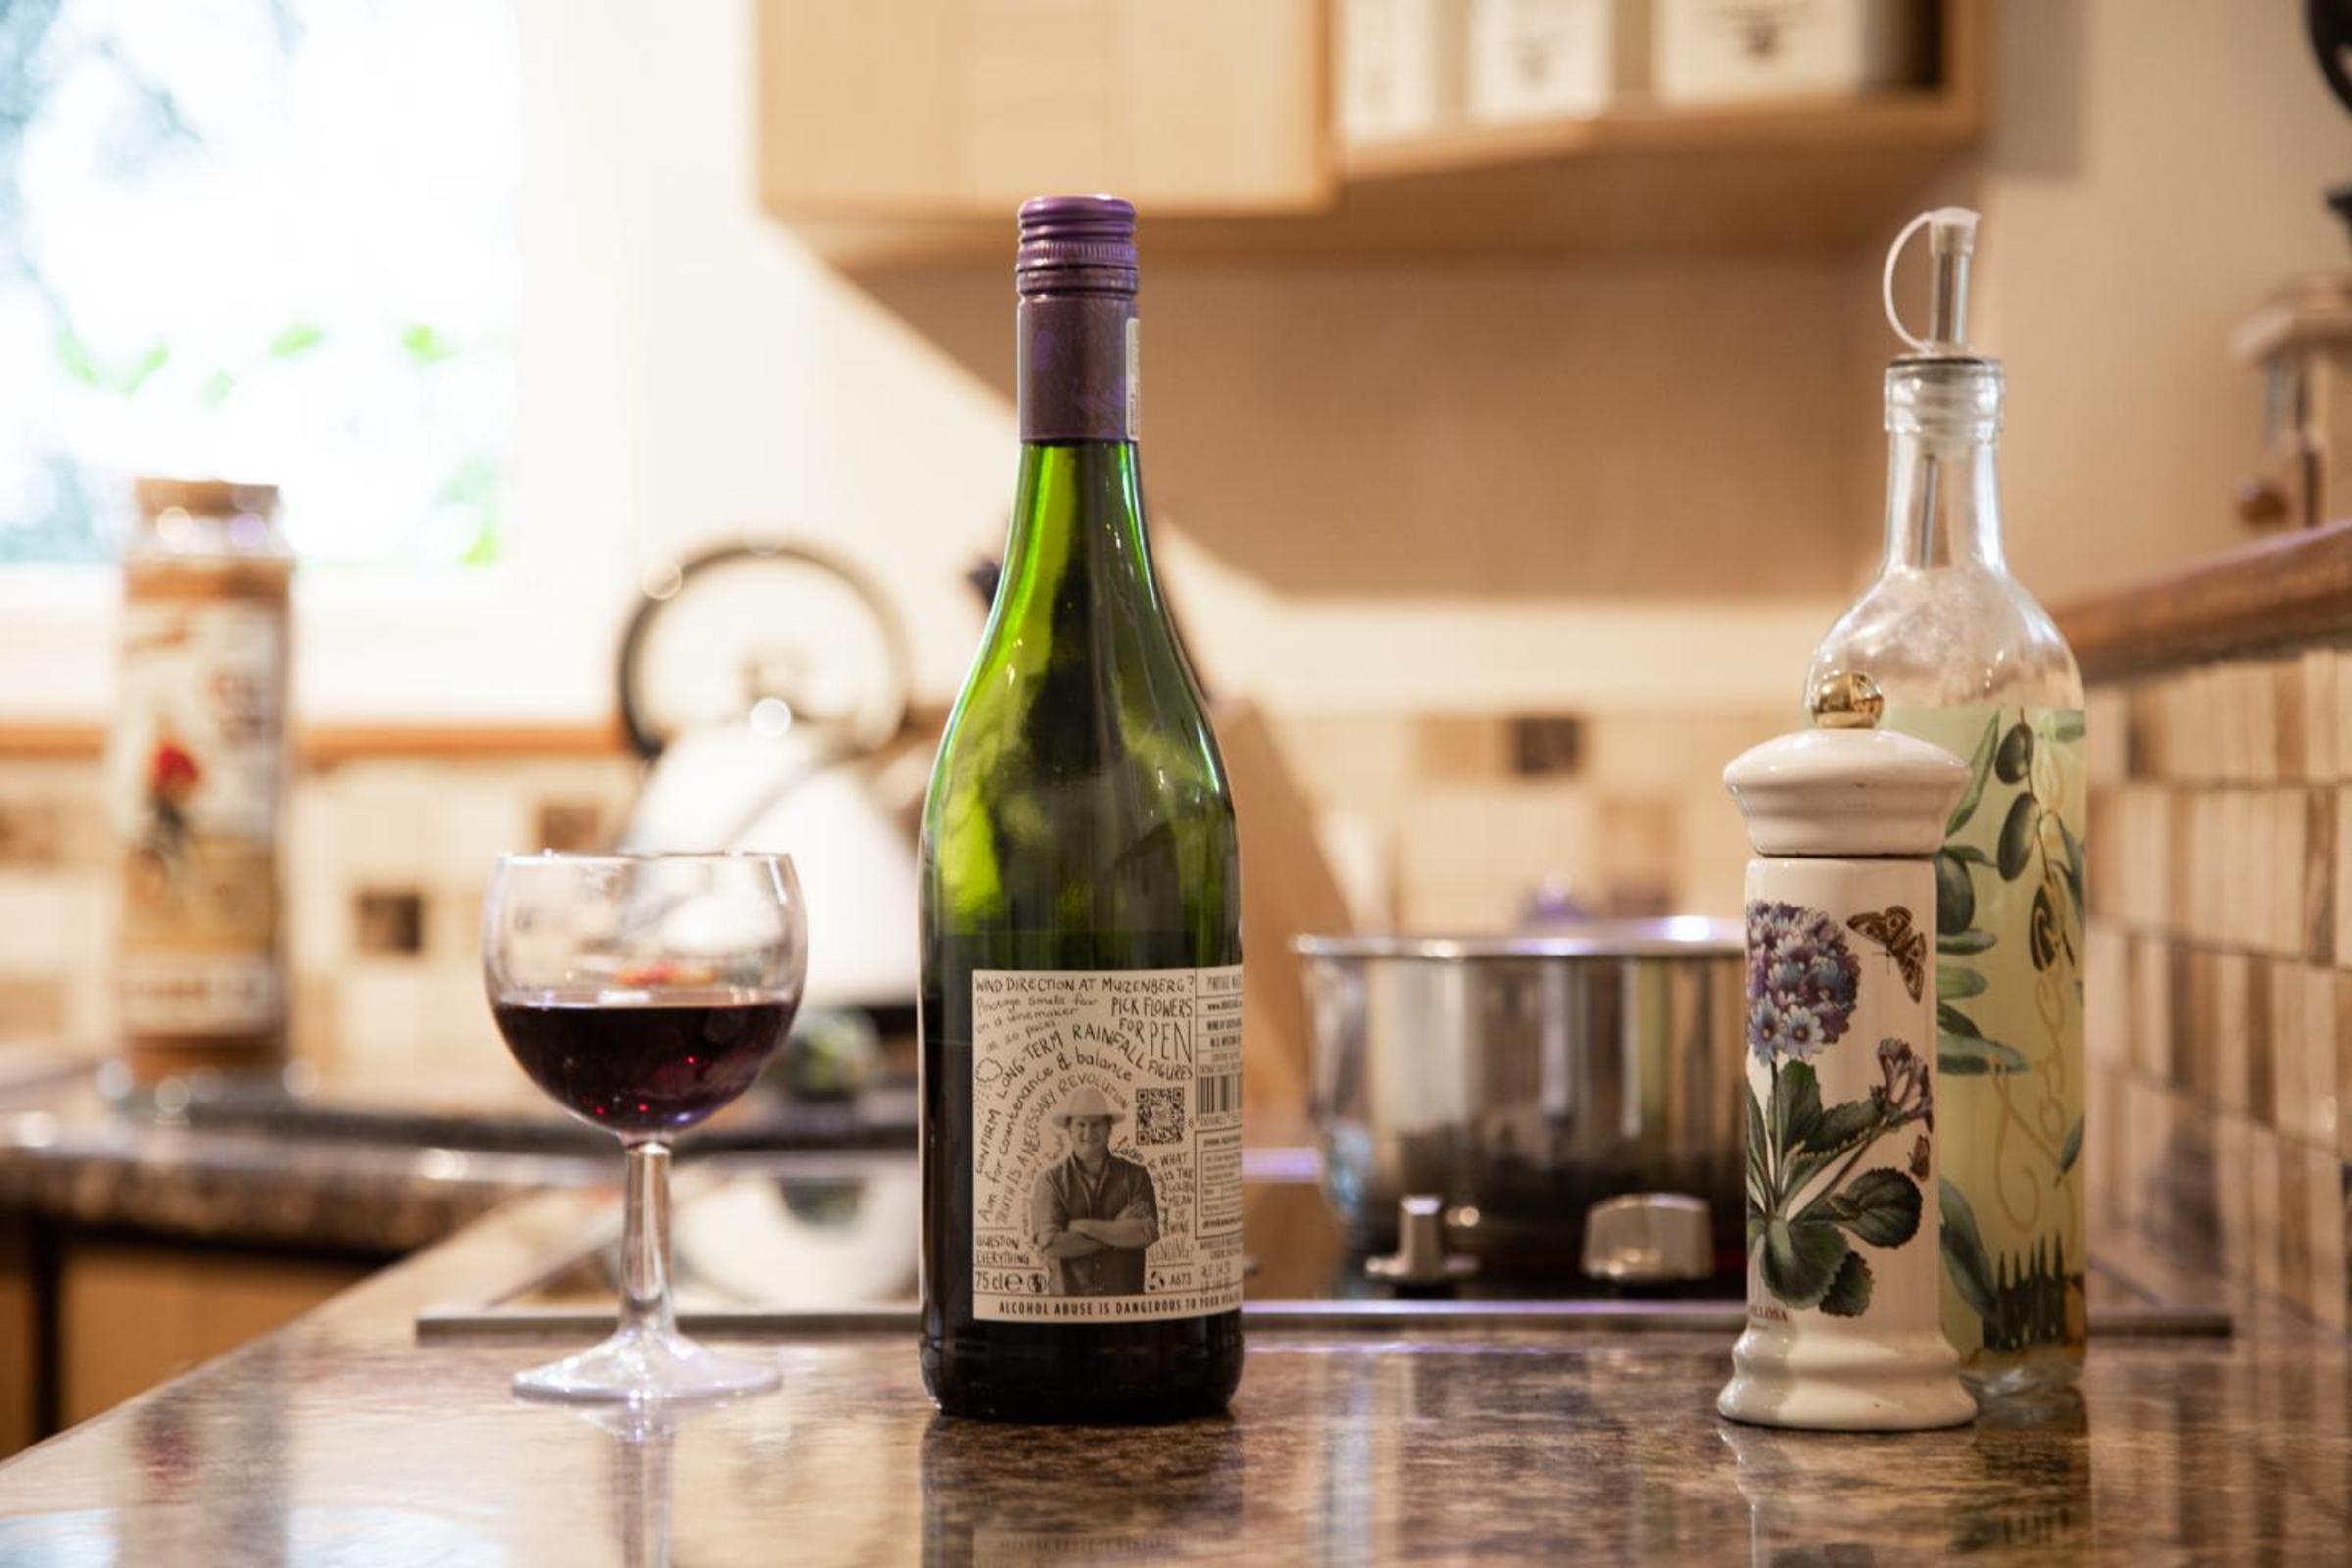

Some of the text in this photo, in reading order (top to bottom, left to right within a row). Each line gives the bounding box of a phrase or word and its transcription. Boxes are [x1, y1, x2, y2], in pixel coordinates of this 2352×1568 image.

[976, 978, 1002, 993] WIND
[1005, 977, 1075, 992] DIRECTION
[1079, 978, 1097, 992] AT
[1111, 996, 1139, 1017] PICK
[1144, 996, 1193, 1019] FLOWERS
[1119, 1017, 1192, 1063] FOR PEN
[996, 1030, 1064, 1100] LONG-TERM
[1072, 1022, 1144, 1070] RAINFALL
[1147, 1059, 1193, 1081] FIGURES
[1075, 1046, 1133, 1082] balance
[1159, 1152, 1188, 1167] WHAT
[1177, 1168, 1194, 1179] THE
[975, 1270, 989, 1291] 75
[992, 1271, 1003, 1290] cl
[999, 1301, 1048, 1315] ALCOHOL
[1054, 1302, 1092, 1315] ABUSE
[1099, 1302, 1110, 1314] IS
[1116, 1298, 1181, 1314] DANGEROUS
[1186, 1298, 1197, 1310] TO
